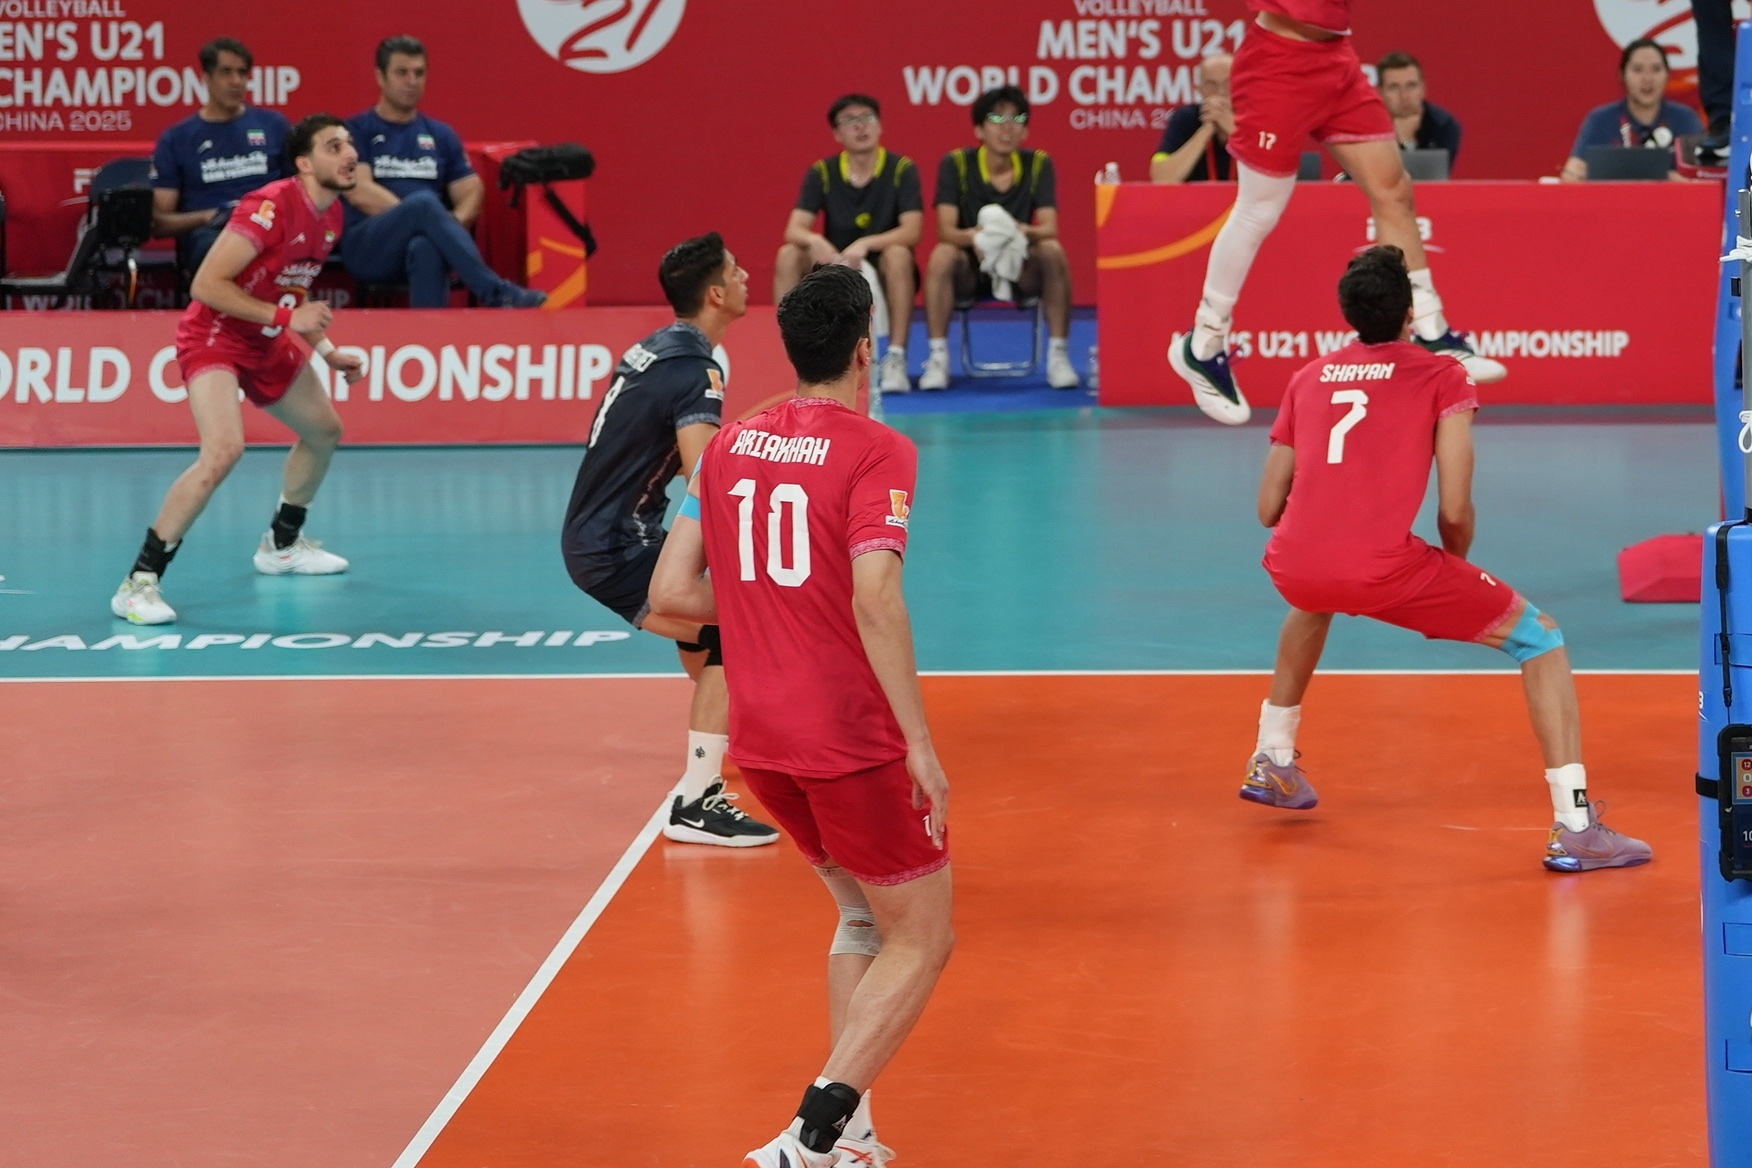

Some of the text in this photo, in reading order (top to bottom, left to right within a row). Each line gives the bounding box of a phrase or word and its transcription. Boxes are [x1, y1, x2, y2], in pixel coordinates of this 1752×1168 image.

[90, 20, 164, 62] U21
[1036, 18, 1246, 60] MEN'S U21
[69, 109, 133, 132] 2025
[1069, 108, 1147, 130] CHINA
[1258, 130, 1277, 150] 17
[1258, 330, 1309, 359] U21
[1320, 362, 1396, 384] SHAYAN
[1327, 388, 1370, 465] 7
[727, 478, 811, 588] 10
[1743, 760, 1752, 769] 12
